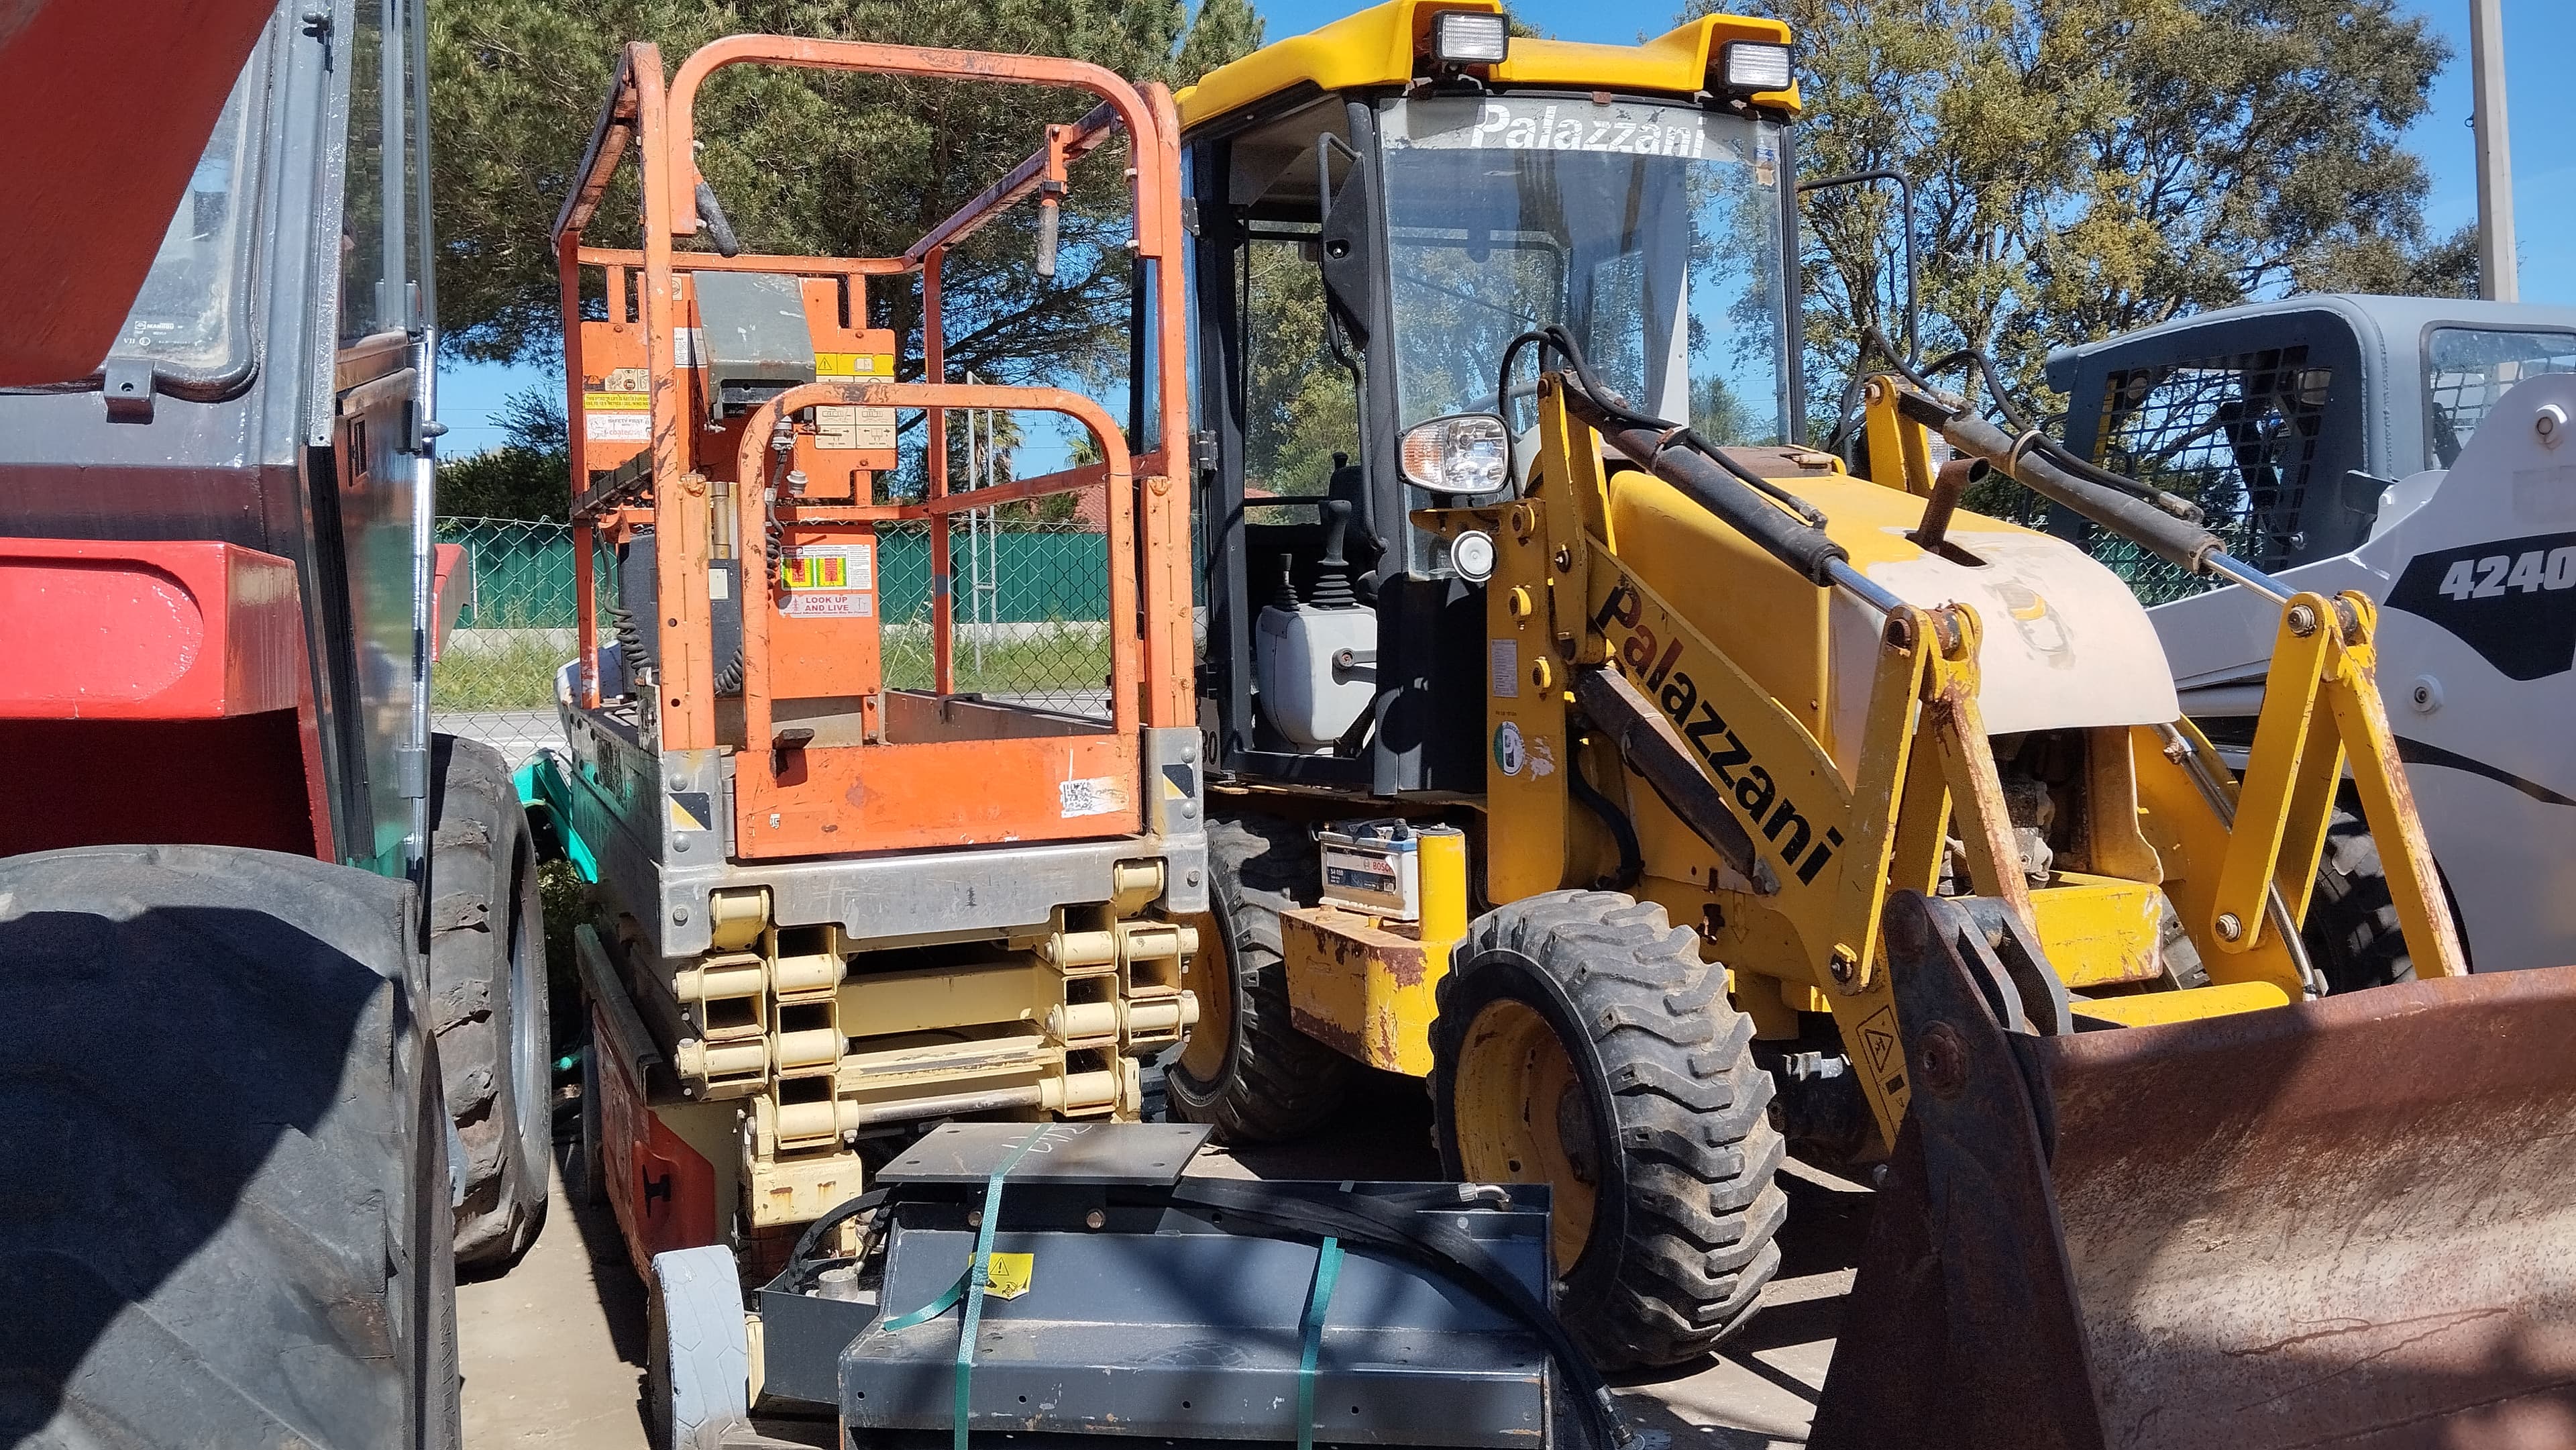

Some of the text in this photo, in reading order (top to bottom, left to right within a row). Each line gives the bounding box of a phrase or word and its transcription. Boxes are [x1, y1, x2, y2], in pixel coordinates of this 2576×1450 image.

[1470, 104, 1707, 158] Palazzani
[2438, 546, 2576, 601] 4240
[1596, 581, 1844, 886] Palazzani
